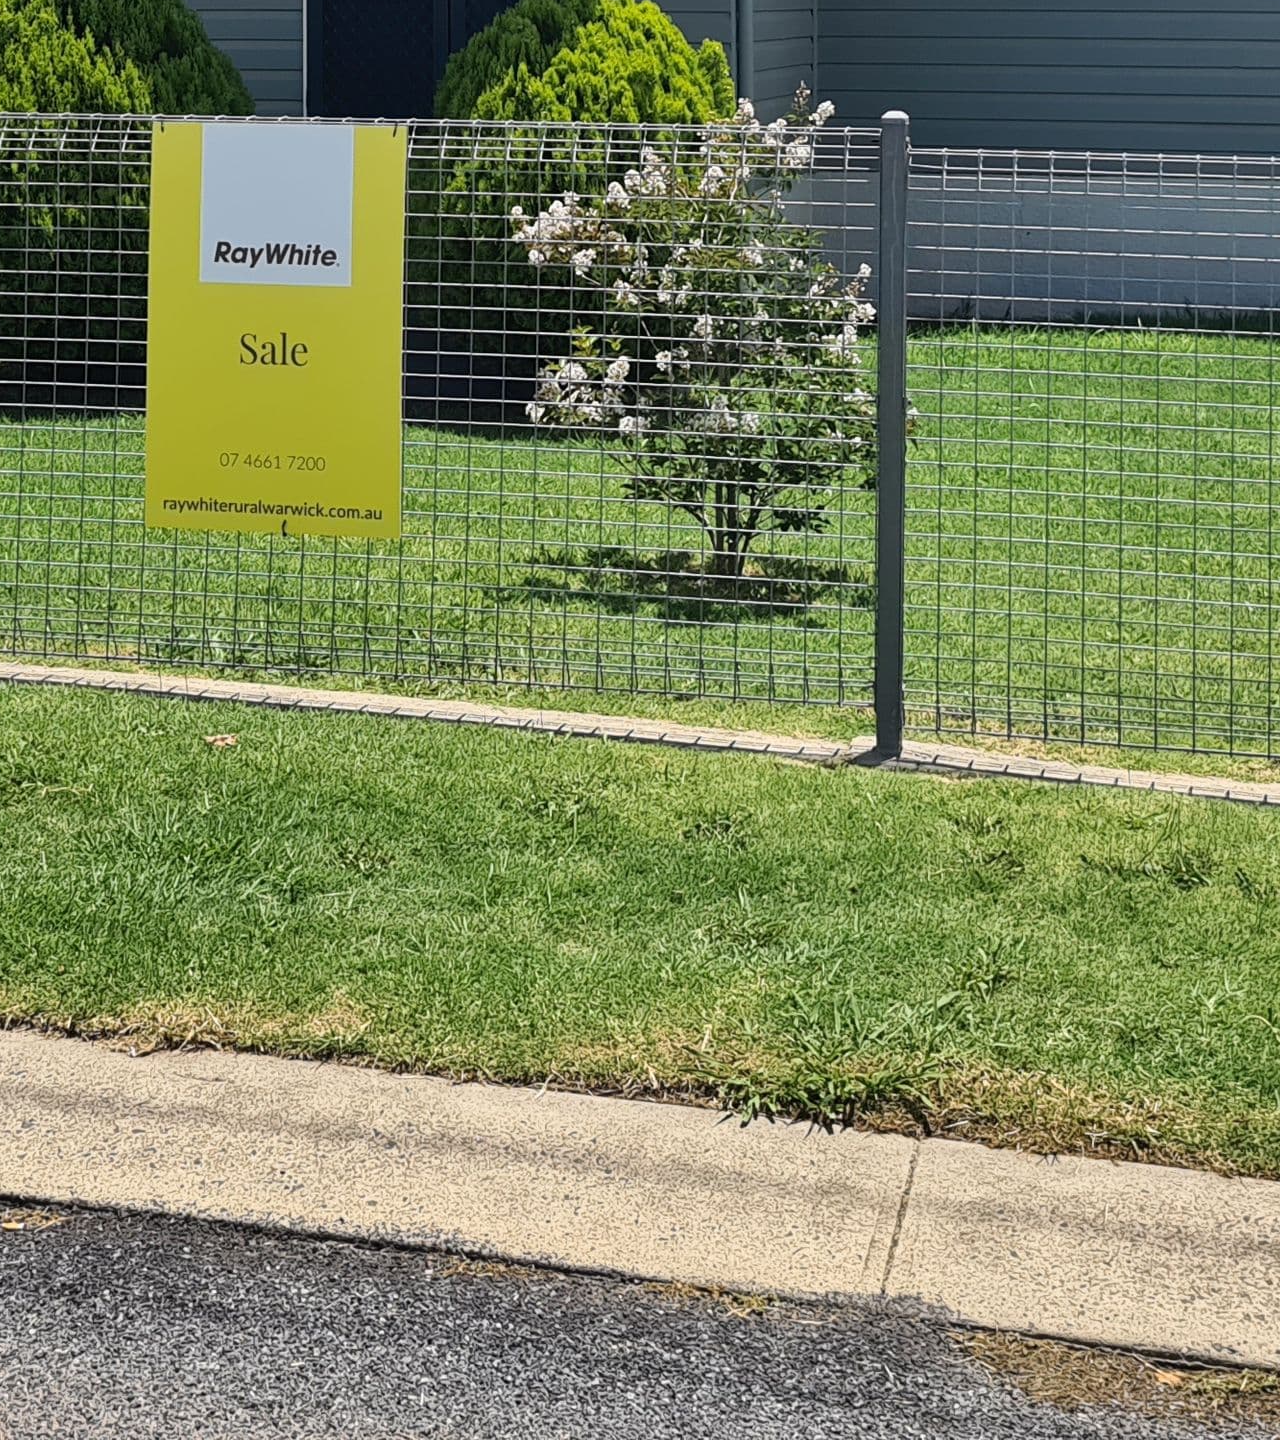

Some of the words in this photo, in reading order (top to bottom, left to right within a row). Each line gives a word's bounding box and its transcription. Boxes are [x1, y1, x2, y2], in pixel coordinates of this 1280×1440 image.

[239, 332, 308, 367] Sale
[220, 452, 239, 468] 07
[243, 454, 281, 470] 4661
[287, 456, 326, 472] 7200
[163, 497, 383, 521] raywhiteruralwarwick.com.au
